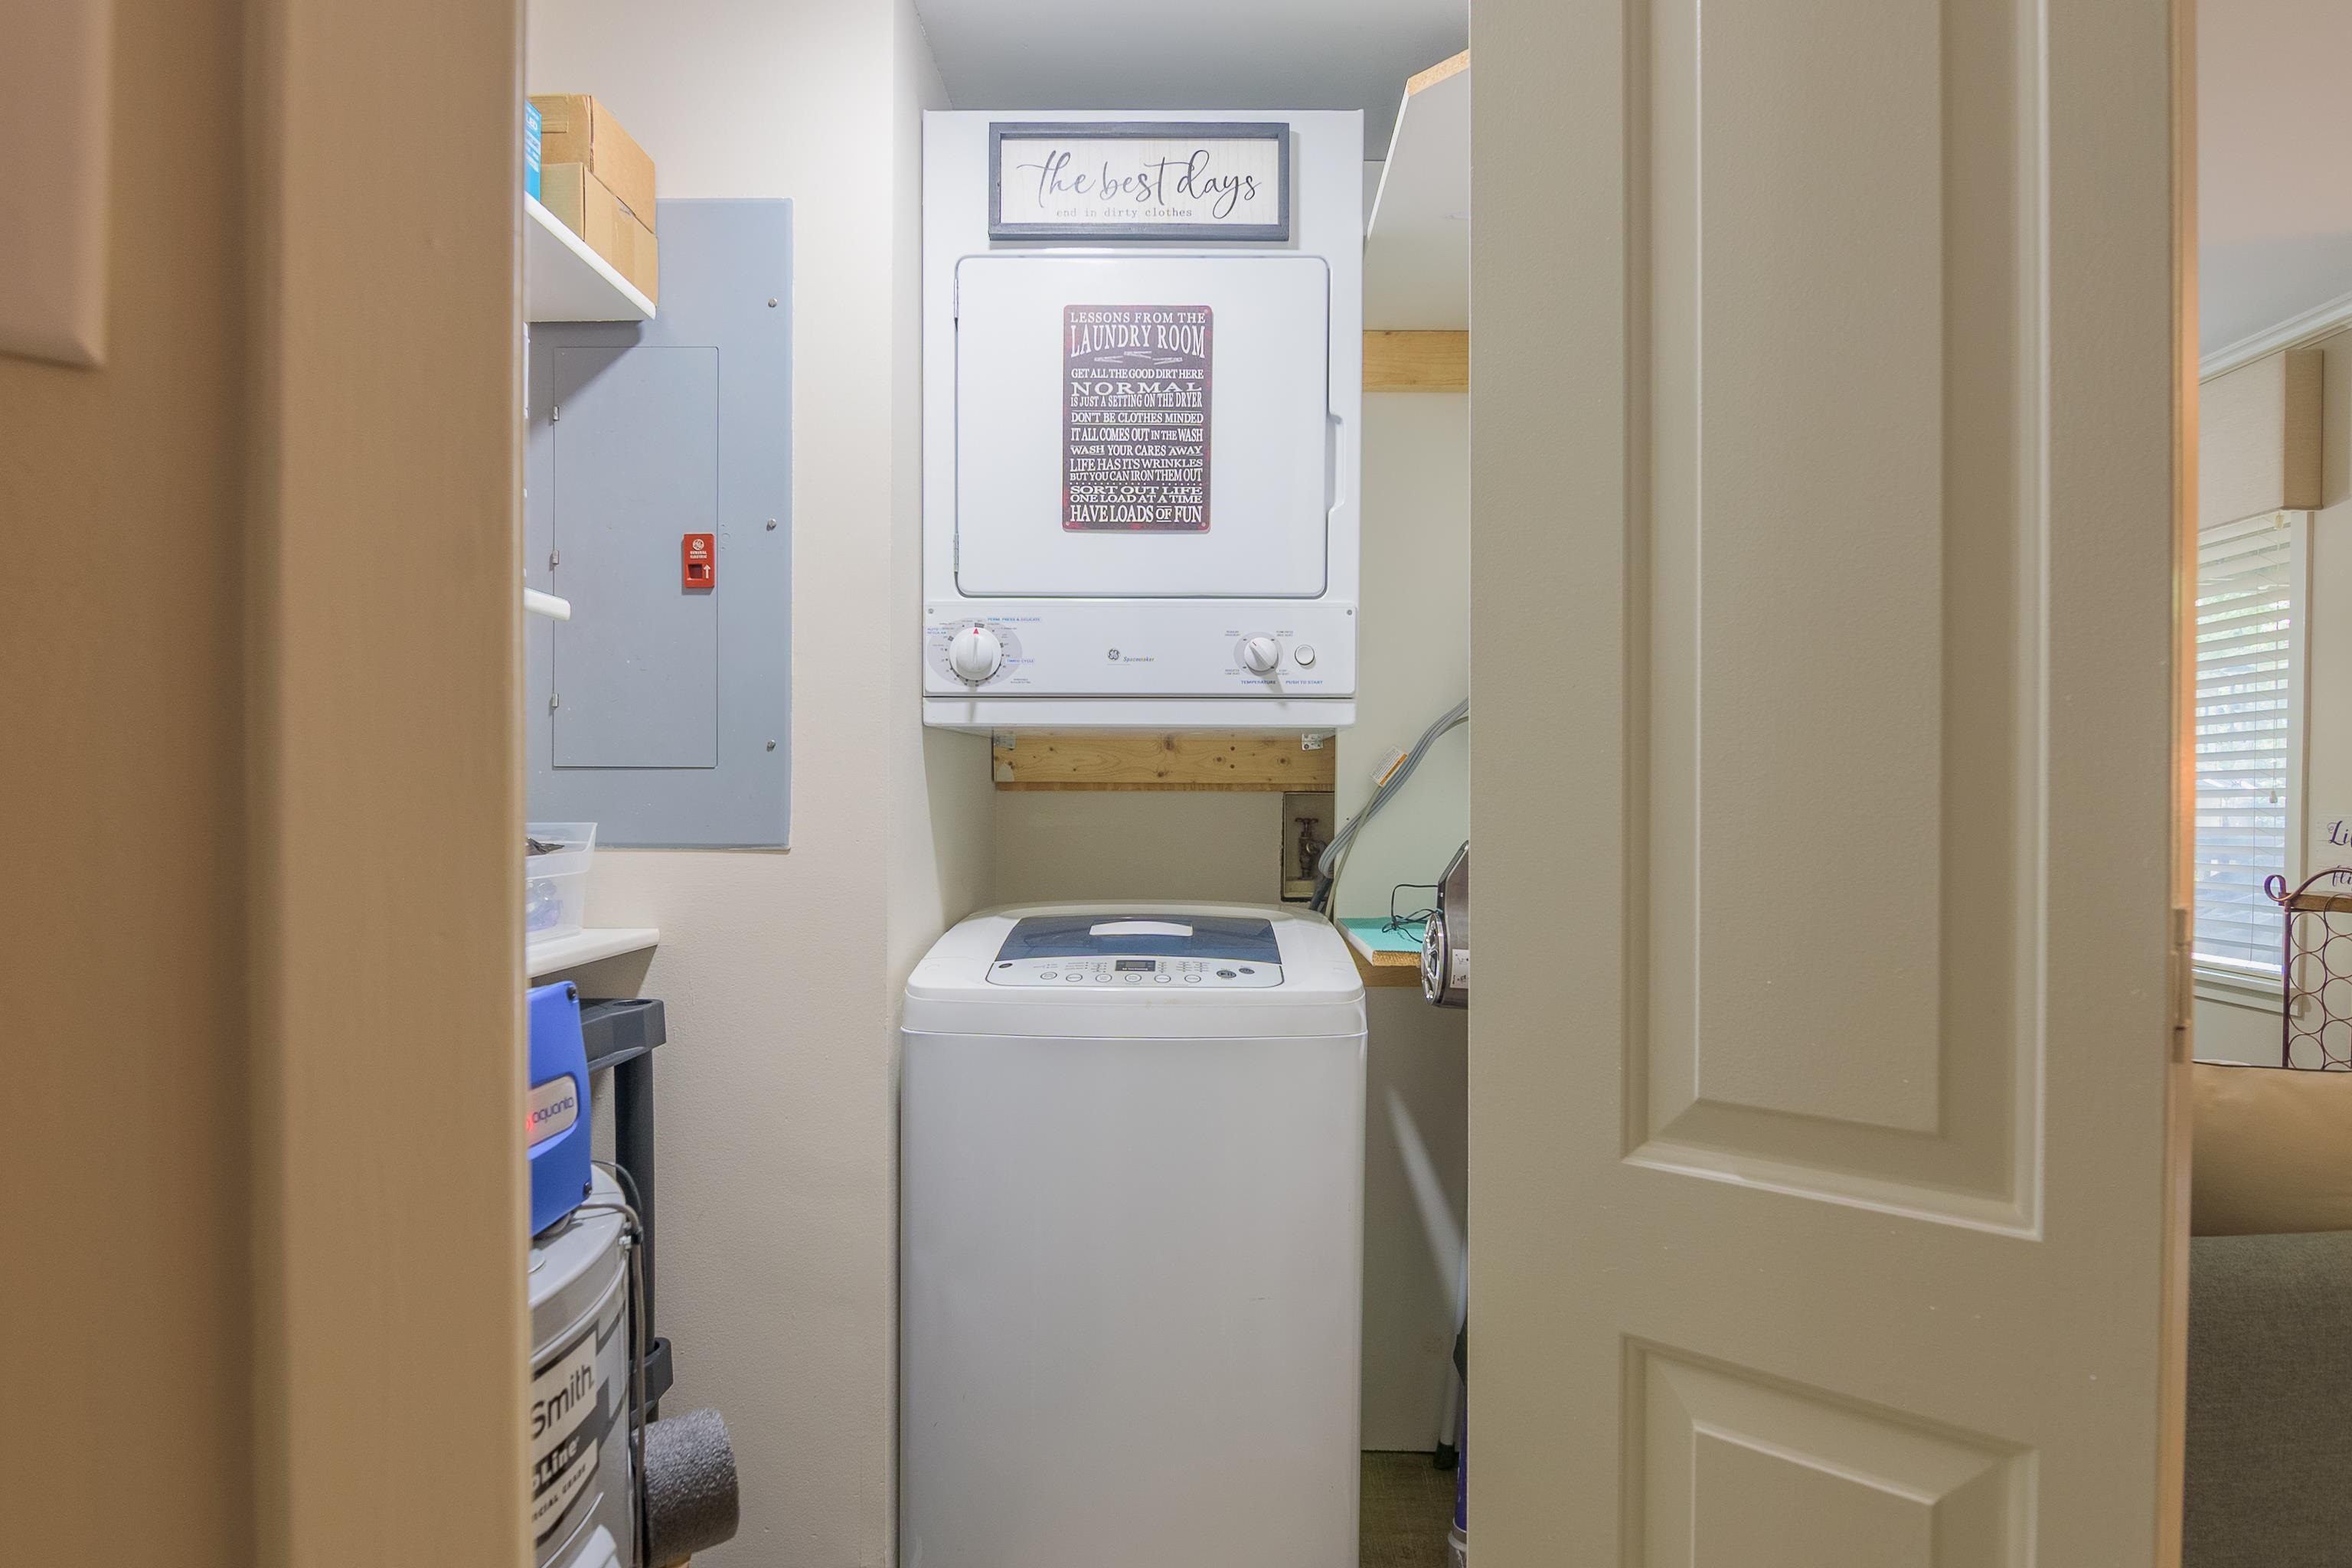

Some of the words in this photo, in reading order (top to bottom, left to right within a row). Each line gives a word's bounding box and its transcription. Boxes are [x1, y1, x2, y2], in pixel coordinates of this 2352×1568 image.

[1017, 150, 1096, 208] the
[1099, 156, 1194, 205] best
[1178, 149, 1261, 219] days
[1057, 207, 1076, 217] end
[1084, 207, 1097, 217] in
[1104, 207, 1138, 218] dirty
[1145, 207, 1193, 217] clothes
[1071, 312, 1130, 323] LESSONS
[1135, 312, 1173, 323] FROM
[1178, 312, 1206, 323] THE
[1071, 325, 1152, 358] LAUNDRY
[1157, 325, 1205, 358] ROOM
[1071, 368, 1089, 378] GET
[1090, 368, 1108, 378] ALL
[1109, 369, 1129, 378] THE
[1129, 369, 1155, 379] GOOD
[1155, 369, 1178, 379] DIRT
[1179, 369, 1204, 379] HERE
[1071, 382, 1202, 397] NORMAL
[1071, 397, 1078, 407] IS
[1080, 396, 1099, 407] JUST
[1101, 396, 1106, 407] A
[1109, 394, 1142, 407] SETTING
[1144, 393, 1155, 407] ON
[1157, 393, 1174, 407] THE
[1176, 392, 1202, 407] DRYER
[1072, 413, 1101, 423] DON'T
[1103, 413, 1116, 423] BE
[1118, 413, 1162, 423] CLOTHES
[1165, 413, 1204, 423] MINDED
[1071, 428, 1080, 441] IT
[1082, 428, 1099, 441] ALL
[1099, 428, 1129, 441] COMES
[1132, 428, 1150, 441] OUT
[1151, 430, 1160, 439] IN
[1161, 430, 1177, 440] THE
[1178, 428, 1203, 442] WASH
[1070, 446, 1104, 455] WASH
[1108, 445, 1133, 456] YOUR
[1135, 445, 1166, 456] CARES
[1168, 446, 1203, 456] AWAY
[1070, 459, 1095, 472] LIFE
[1097, 459, 1122, 470] HAS
[1122, 459, 1140, 470] ITS
[1141, 459, 1203, 468] WRINKLES
[1070, 472, 1089, 481] BUT
[1089, 472, 1108, 481] YOU
[1109, 471, 1129, 481] CAN
[1131, 469, 1155, 481] IRON
[1155, 469, 1182, 481] THEM
[1183, 468, 1202, 482] OUT
[1070, 486, 1118, 495] SORT
[1121, 486, 1159, 495] OUT
[1162, 486, 1202, 495] LIFE
[1100, 495, 1137, 503] LOAD
[1137, 495, 1156, 503] AT
[1070, 505, 1108, 522] HAVE
[1110, 505, 1154, 522] LOADS
[1155, 508, 1172, 520] OF
[1174, 506, 1202, 522] FUN
[2327, 820, 2352, 848] Li
[531, 1364, 594, 1441] Smith
